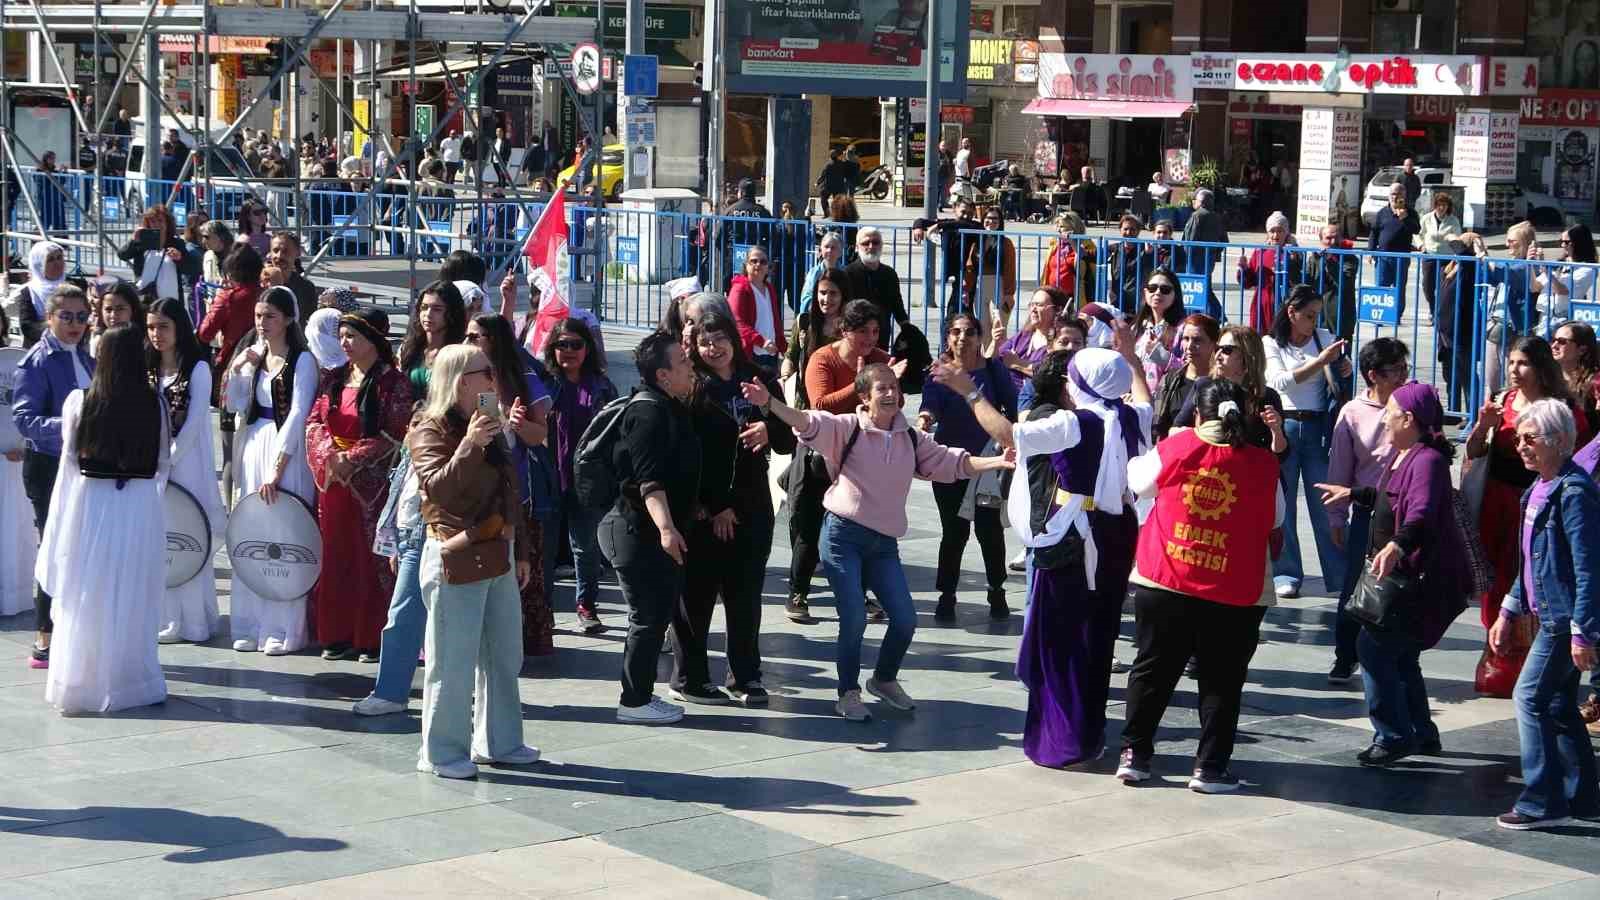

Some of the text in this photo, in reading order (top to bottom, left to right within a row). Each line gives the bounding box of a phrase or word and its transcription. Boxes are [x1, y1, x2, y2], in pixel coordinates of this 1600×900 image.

[761, 6, 861, 20] iftar hazırlıklarında
[645, 15, 664, 29] ÜFE
[970, 39, 1013, 64] MONEY
[1054, 56, 1176, 98] mis simit
[1237, 57, 1417, 88] eczane optik
[1180, 279, 1204, 294] OLİS
[1183, 294, 1194, 305] 07
[1362, 293, 1395, 308] POLİS
[1371, 308, 1384, 320] 07
[1174, 521, 1230, 549] EMEK
[1166, 540, 1229, 573] PARTİSİ
